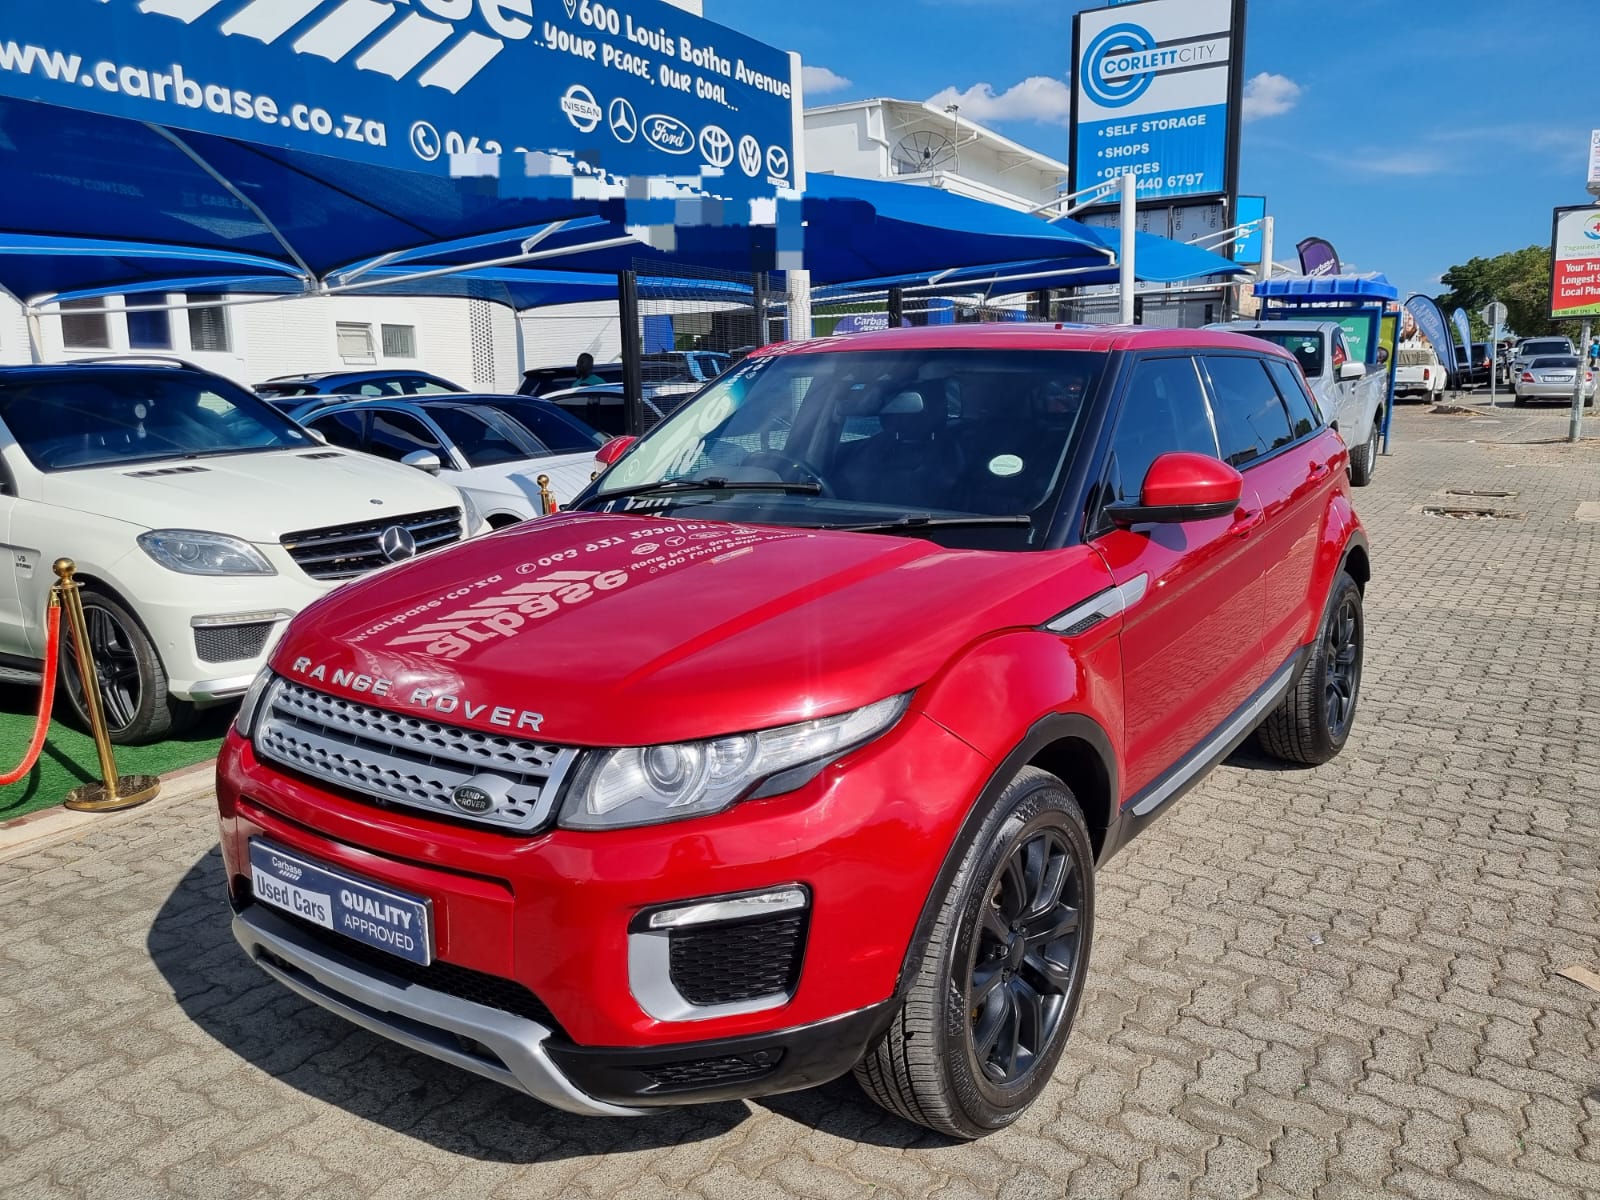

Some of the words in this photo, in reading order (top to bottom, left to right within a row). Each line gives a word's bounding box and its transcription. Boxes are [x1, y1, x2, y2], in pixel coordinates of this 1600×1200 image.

[579, 0, 620, 35] 600
[626, 15, 675, 57] Louis
[680, 37, 731, 77] Botha
[735, 59, 792, 99] Avenue
[659, 65, 692, 93] OUR
[563, 100, 600, 118] NISSAN
[652, 119, 685, 148] Ford
[1105, 123, 1138, 137] SELF
[1141, 114, 1206, 132] STORAGE
[1105, 143, 1150, 158] SHOPS
[1104, 162, 1160, 178] OFFICES
[1136, 177, 1163, 190] 440
[1167, 173, 1204, 187] 6797
[1566, 263, 1584, 272] Your
[1561, 274, 1595, 286] Longest
[1561, 286, 1583, 296] Local
[854, 316, 889, 326] Carbas
[292, 656, 393, 697] RANGE
[410, 687, 545, 733] ROVER
[460, 790, 480, 800] LAND
[461, 798, 486, 809] ROVER
[271, 856, 303, 876] Carbase
[256, 874, 289, 908] Used
[292, 890, 326, 922] Cars
[341, 889, 412, 929] QUALITY
[344, 915, 415, 952] APPROVED
